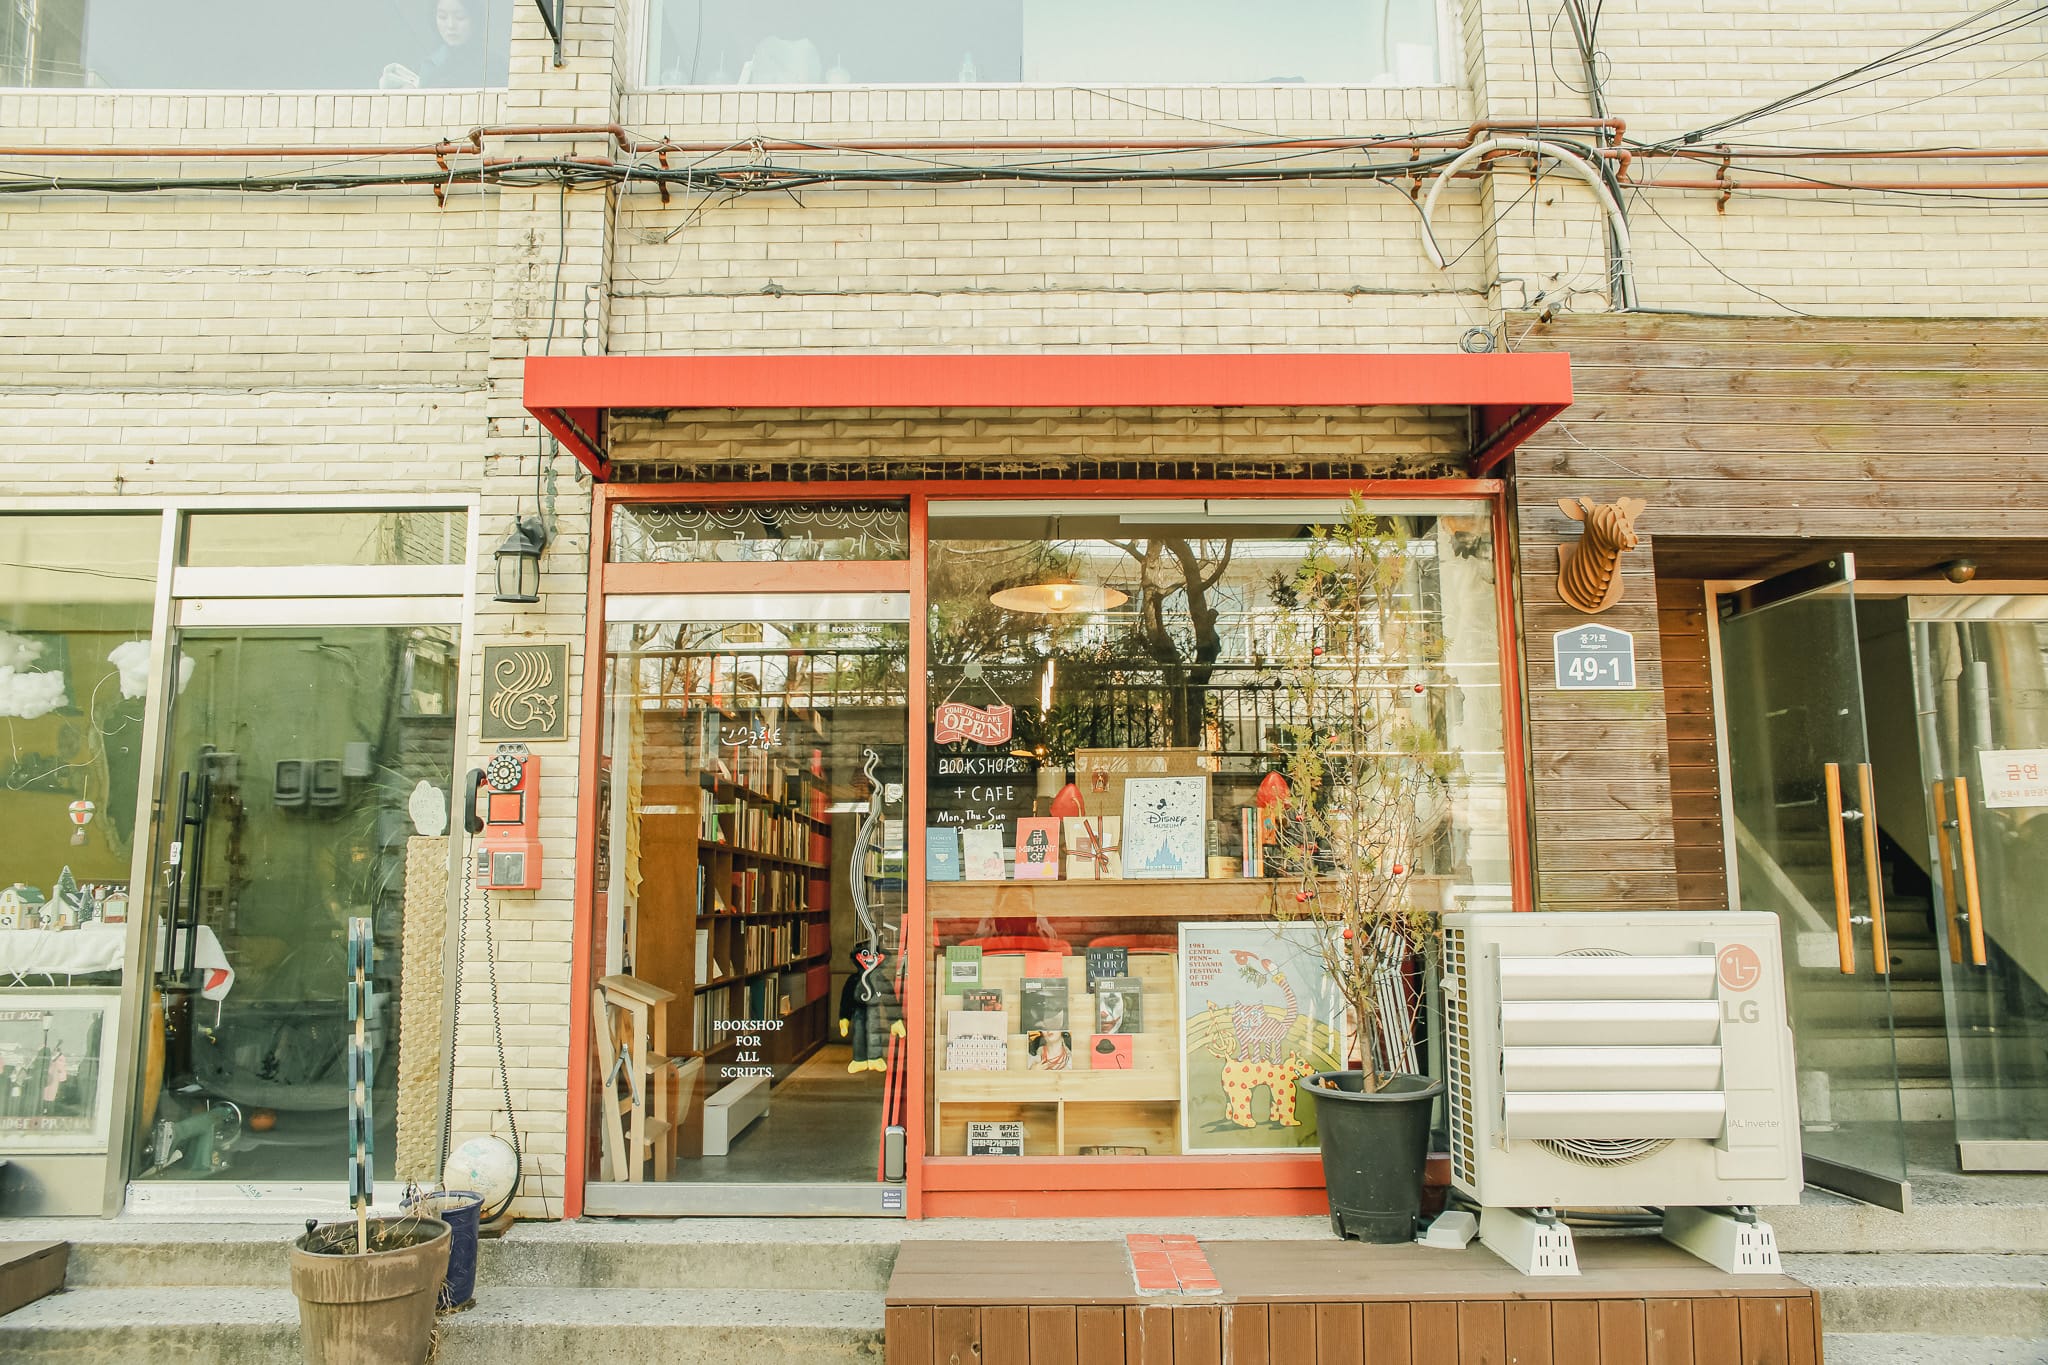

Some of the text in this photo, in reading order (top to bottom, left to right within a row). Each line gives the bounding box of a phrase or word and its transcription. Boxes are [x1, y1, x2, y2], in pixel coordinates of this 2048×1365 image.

[1579, 633, 1608, 645] 증가로
[1568, 656, 1620, 682] 49-1
[975, 713, 986, 722] WE
[987, 714, 1002, 723] ARE
[943, 713, 1003, 739] OPEN
[938, 758, 1015, 775] BOOKSHOP
[2006, 763, 2039, 781] 금연
[971, 785, 1014, 802] CAFE
[1722, 1000, 1760, 1024] LG
[713, 1020, 784, 1031] BOOKSHOP
[735, 1036, 761, 1046] FOR
[735, 1052, 760, 1062] ALL
[720, 1067, 775, 1078] SCRIPTS.
[1744, 1119, 1781, 1128] Inverter
